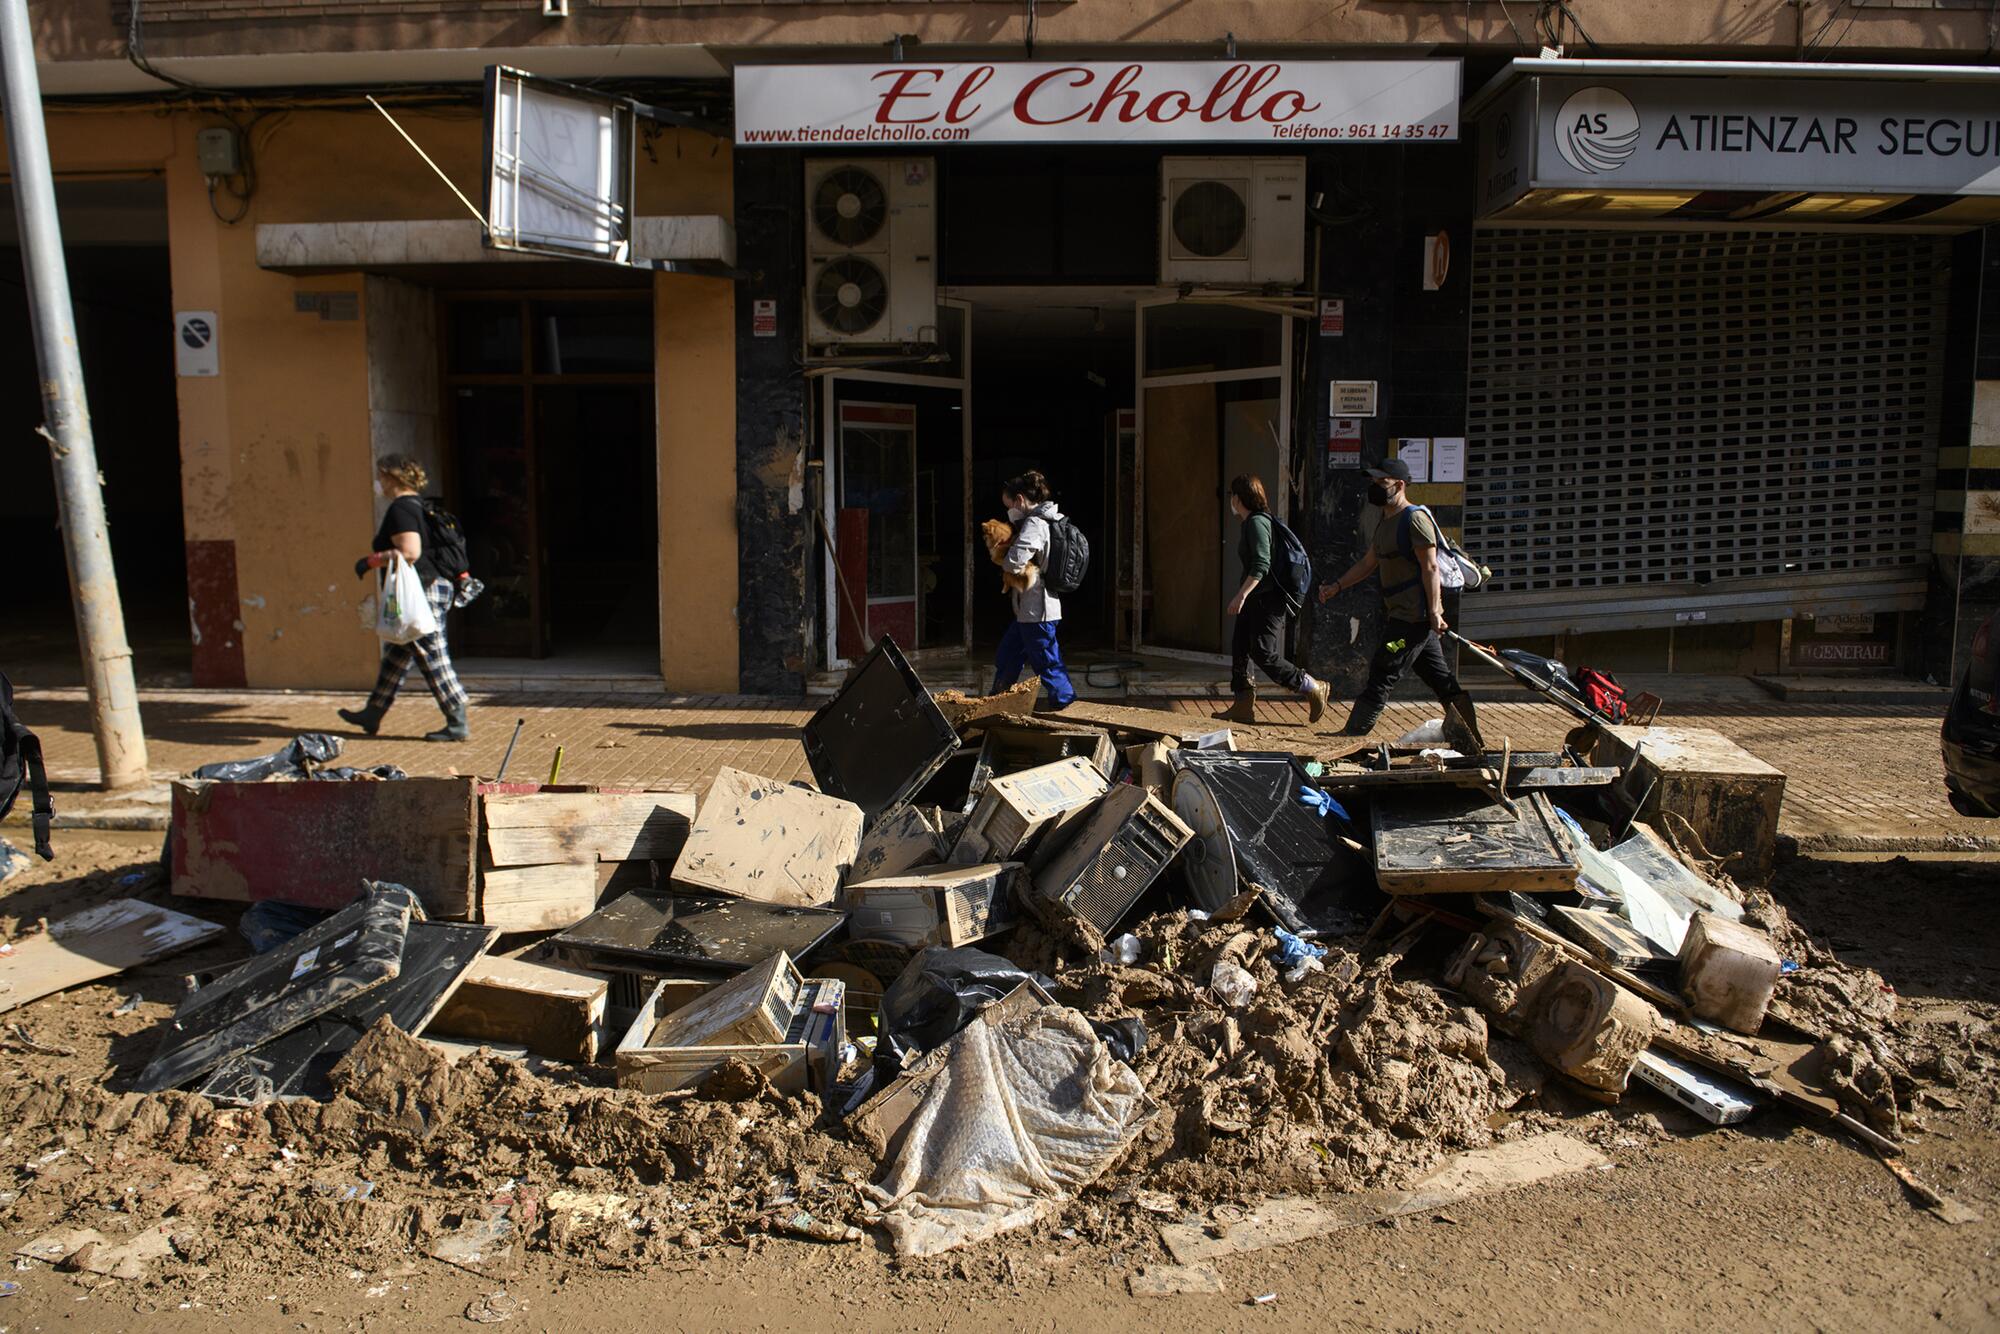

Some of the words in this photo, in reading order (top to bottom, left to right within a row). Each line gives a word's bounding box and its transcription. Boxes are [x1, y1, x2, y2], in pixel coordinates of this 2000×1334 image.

[871, 66, 994, 124] El
[1012, 63, 1321, 125] Chollo
[744, 124, 970, 143] www.tiendaelchollo.com
[1272, 123, 1344, 141] Teléfono:
[1347, 124, 1376, 138] 961
[1381, 124, 1401, 138] 14
[1405, 124, 1425, 138] 35
[1428, 124, 1449, 138] 47
[1573, 113, 1608, 135] AS
[1655, 114, 1858, 155] ATIENZAR
[1877, 117, 2000, 158] SEGU
[1813, 645, 1885, 660] GENERALI
